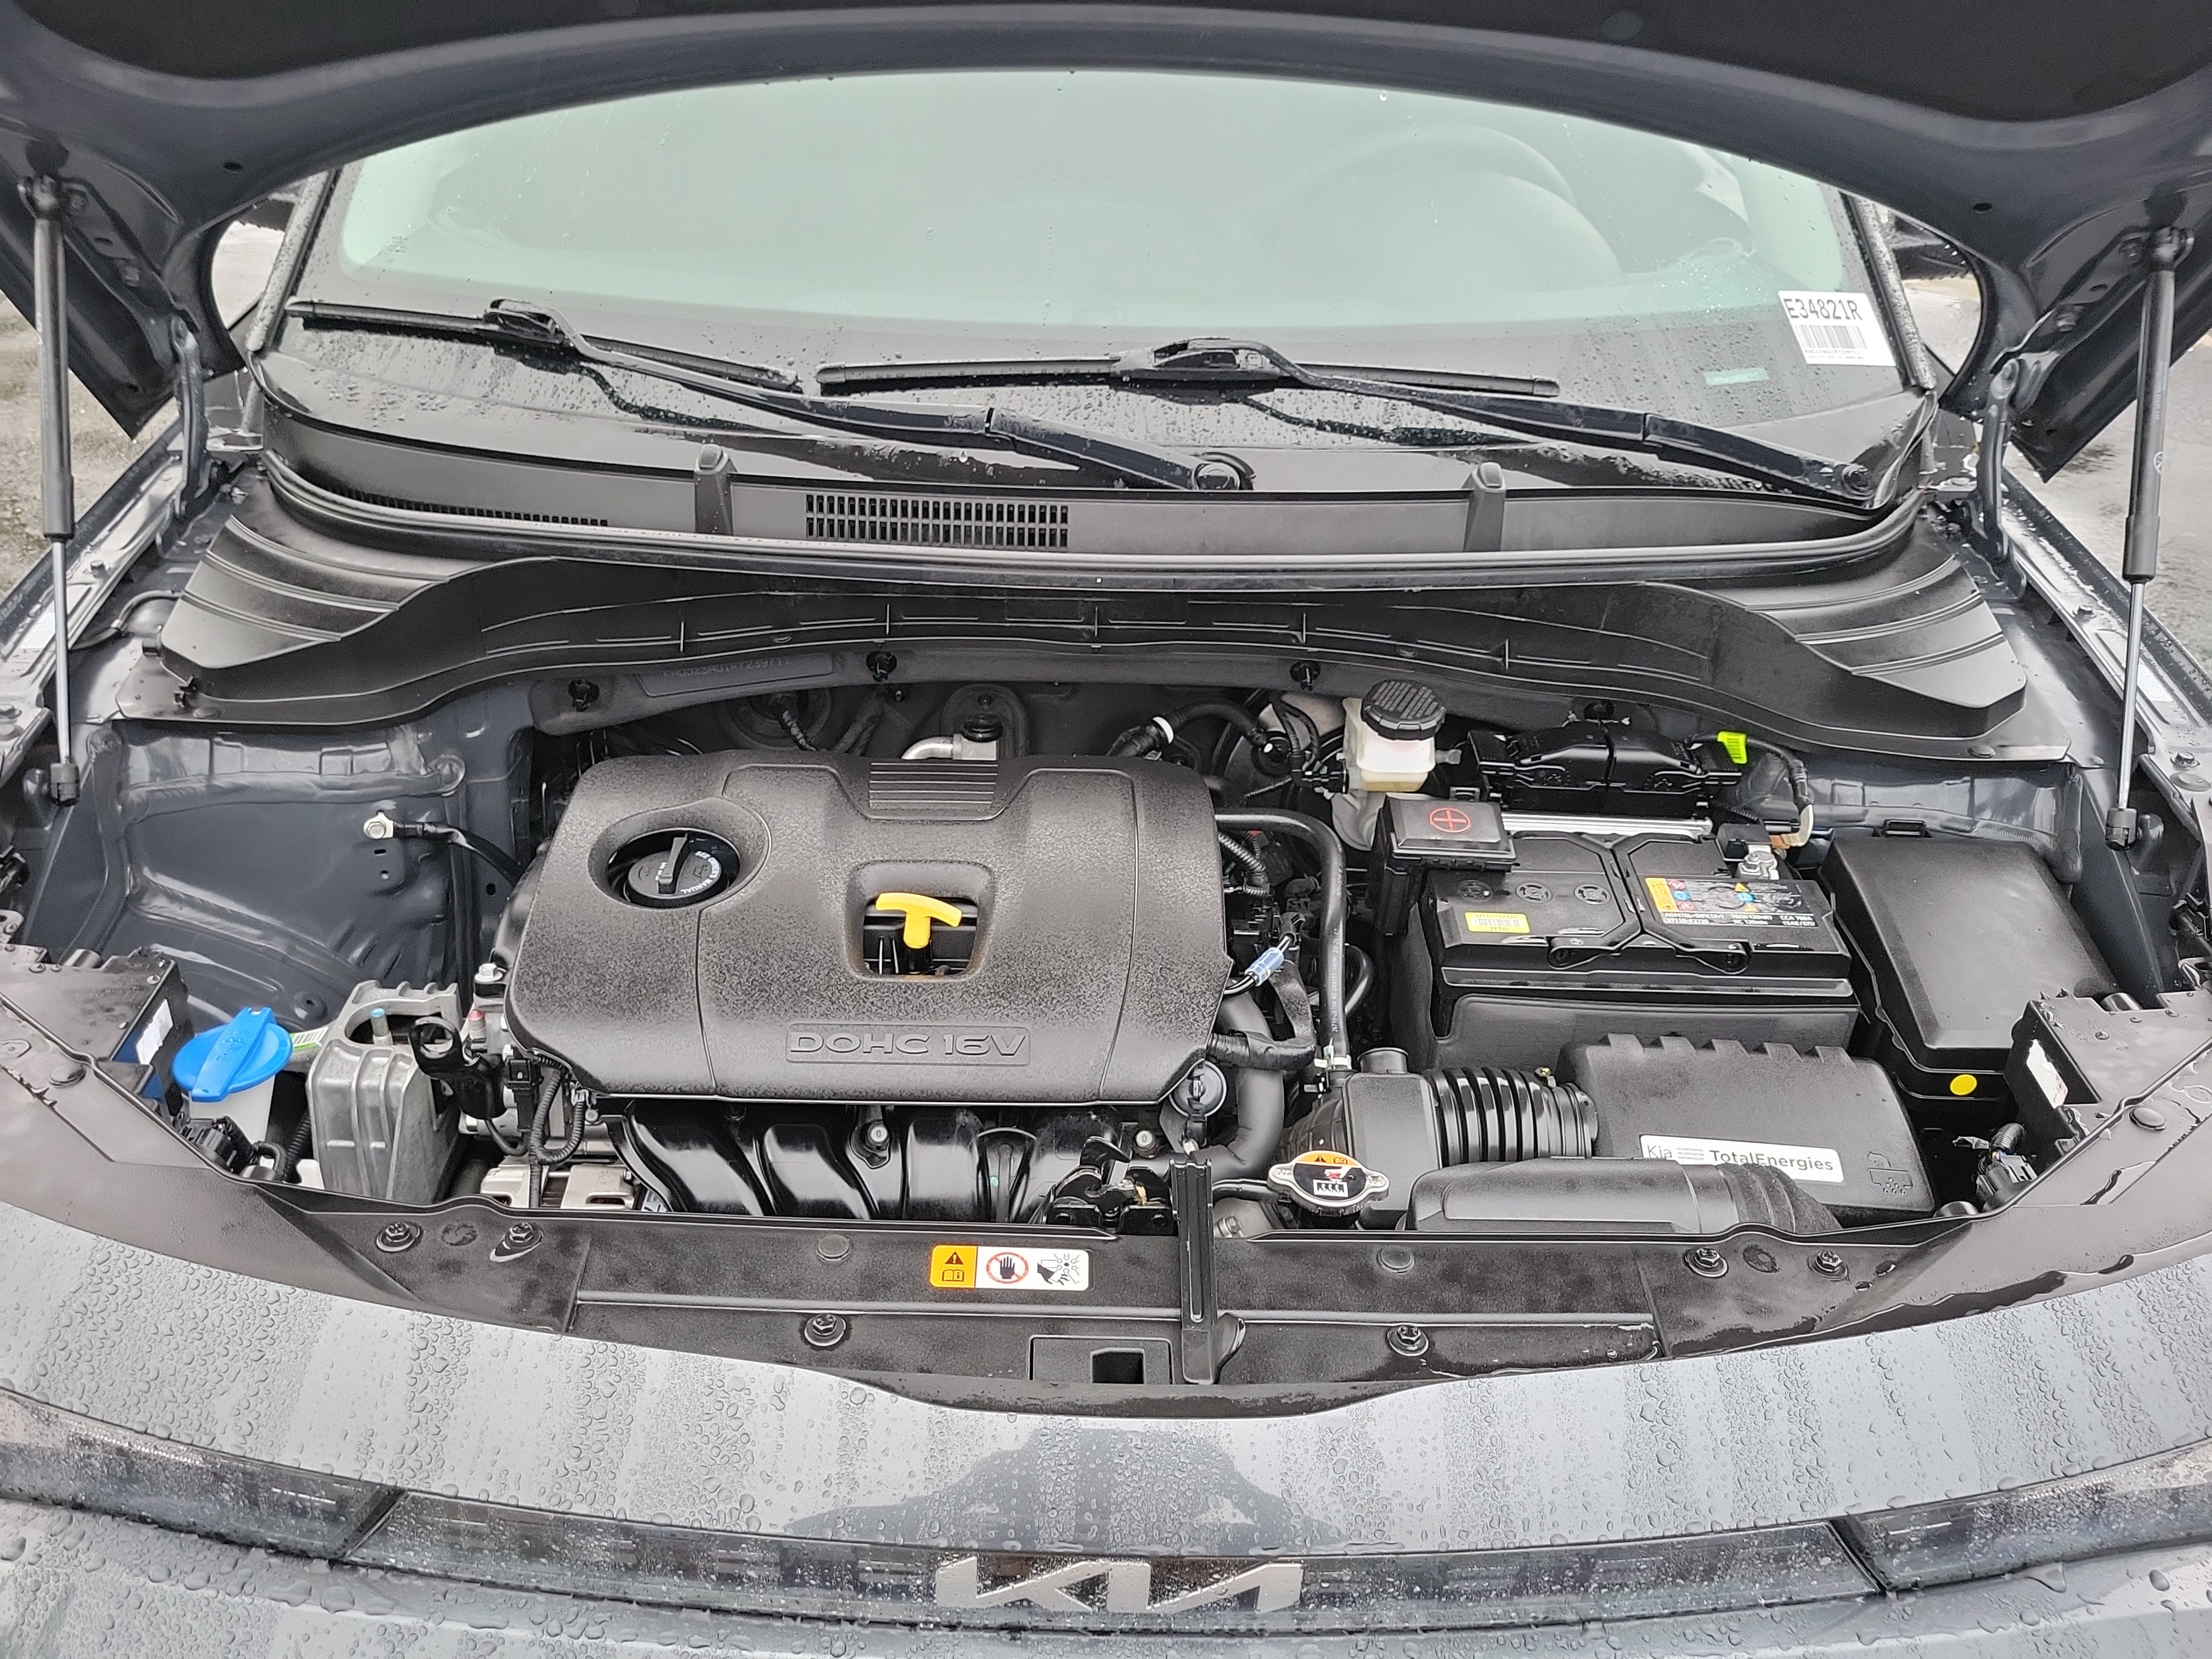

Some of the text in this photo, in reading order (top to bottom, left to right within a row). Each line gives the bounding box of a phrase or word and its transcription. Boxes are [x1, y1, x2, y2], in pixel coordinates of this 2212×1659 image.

[1783, 298, 1863, 320] E34821R
[680, 878, 713, 894] MANUAL
[790, 1031, 1026, 1056] DOHC 16V
[1647, 1145, 1833, 1171] Kia TotalEnergies
[935, 1556, 1304, 1613] KIA
